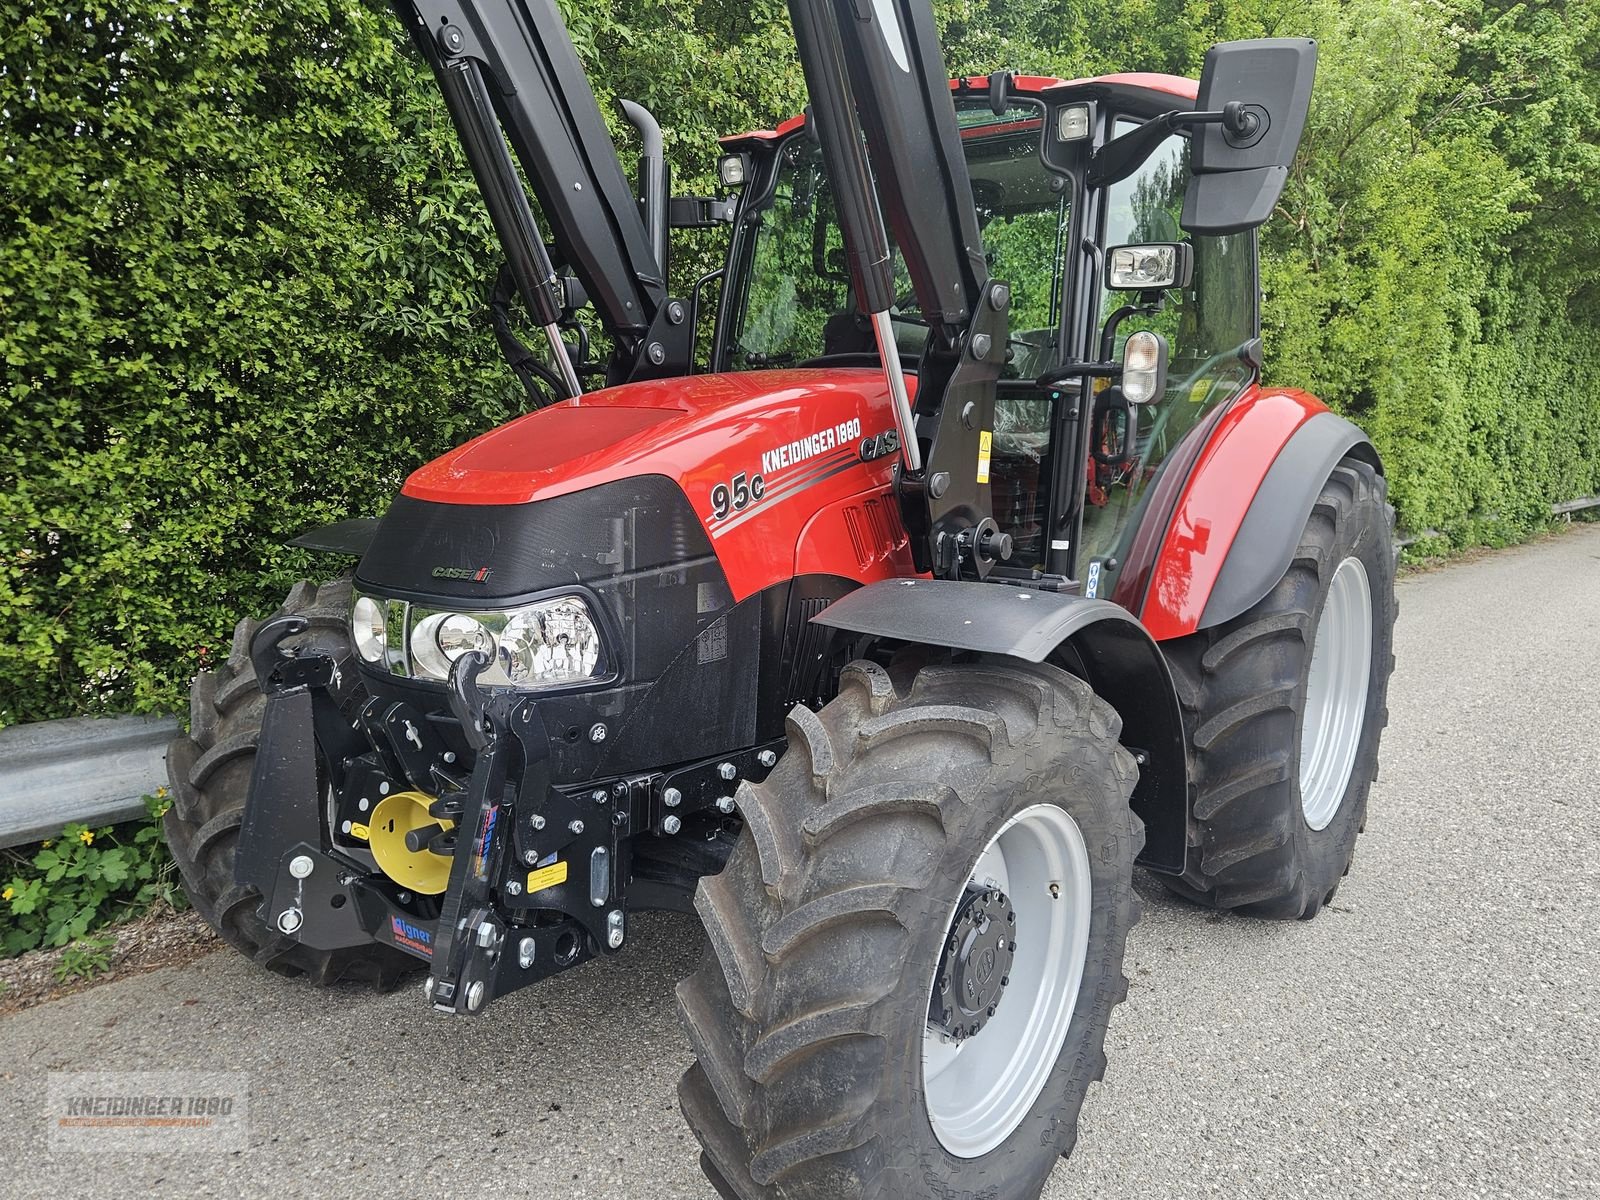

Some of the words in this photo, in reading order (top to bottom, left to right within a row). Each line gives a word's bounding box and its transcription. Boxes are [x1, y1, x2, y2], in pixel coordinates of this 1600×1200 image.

[762, 428, 835, 474] KNEIDINGER
[836, 417, 861, 445] 1880
[431, 566, 472, 580] CASE
